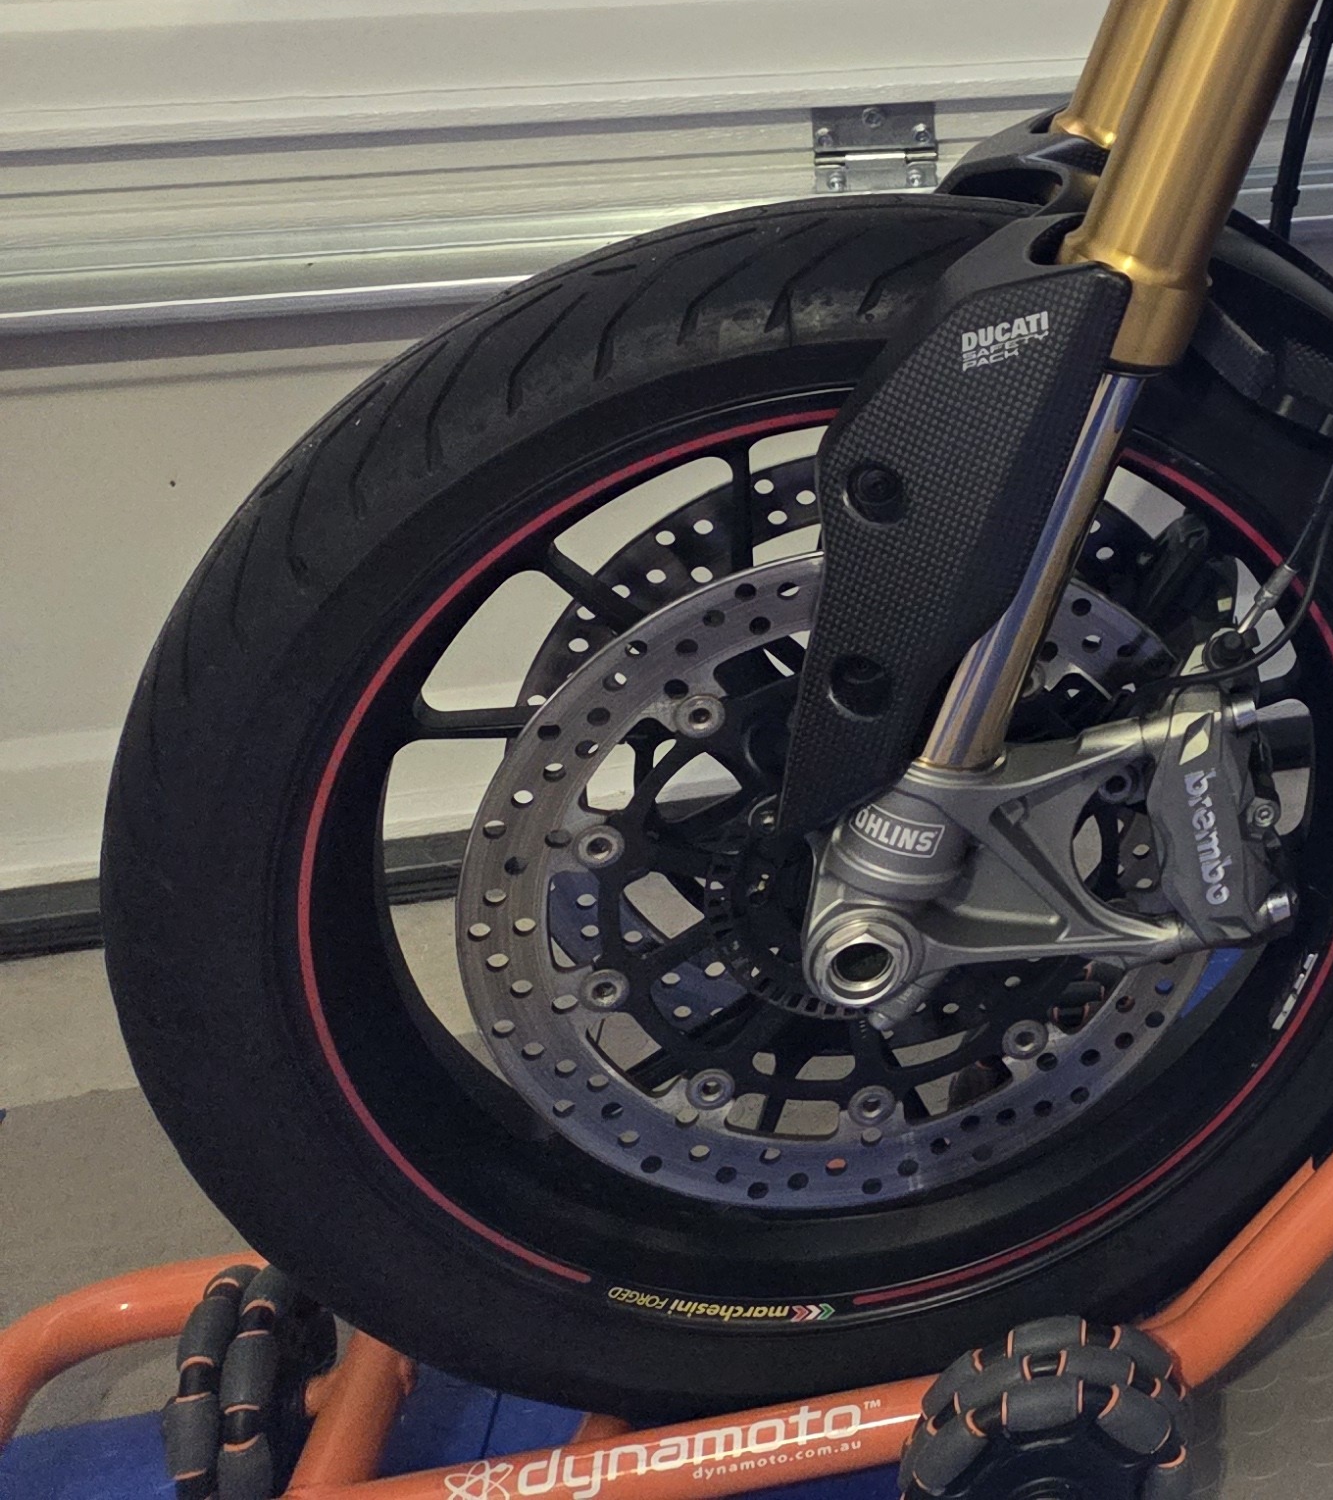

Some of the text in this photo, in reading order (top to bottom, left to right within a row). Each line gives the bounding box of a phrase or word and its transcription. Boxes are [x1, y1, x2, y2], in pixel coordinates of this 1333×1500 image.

[962, 311, 1049, 352] DUCATI
[962, 331, 1049, 362] SAFETY
[962, 349, 1019, 371] PACK
[1184, 768, 1232, 905] brembo
[608, 1286, 789, 1321] marchesini FORGED
[517, 1403, 862, 1500] dynamoto
[692, 1439, 862, 1480] dynamoto.com.au
